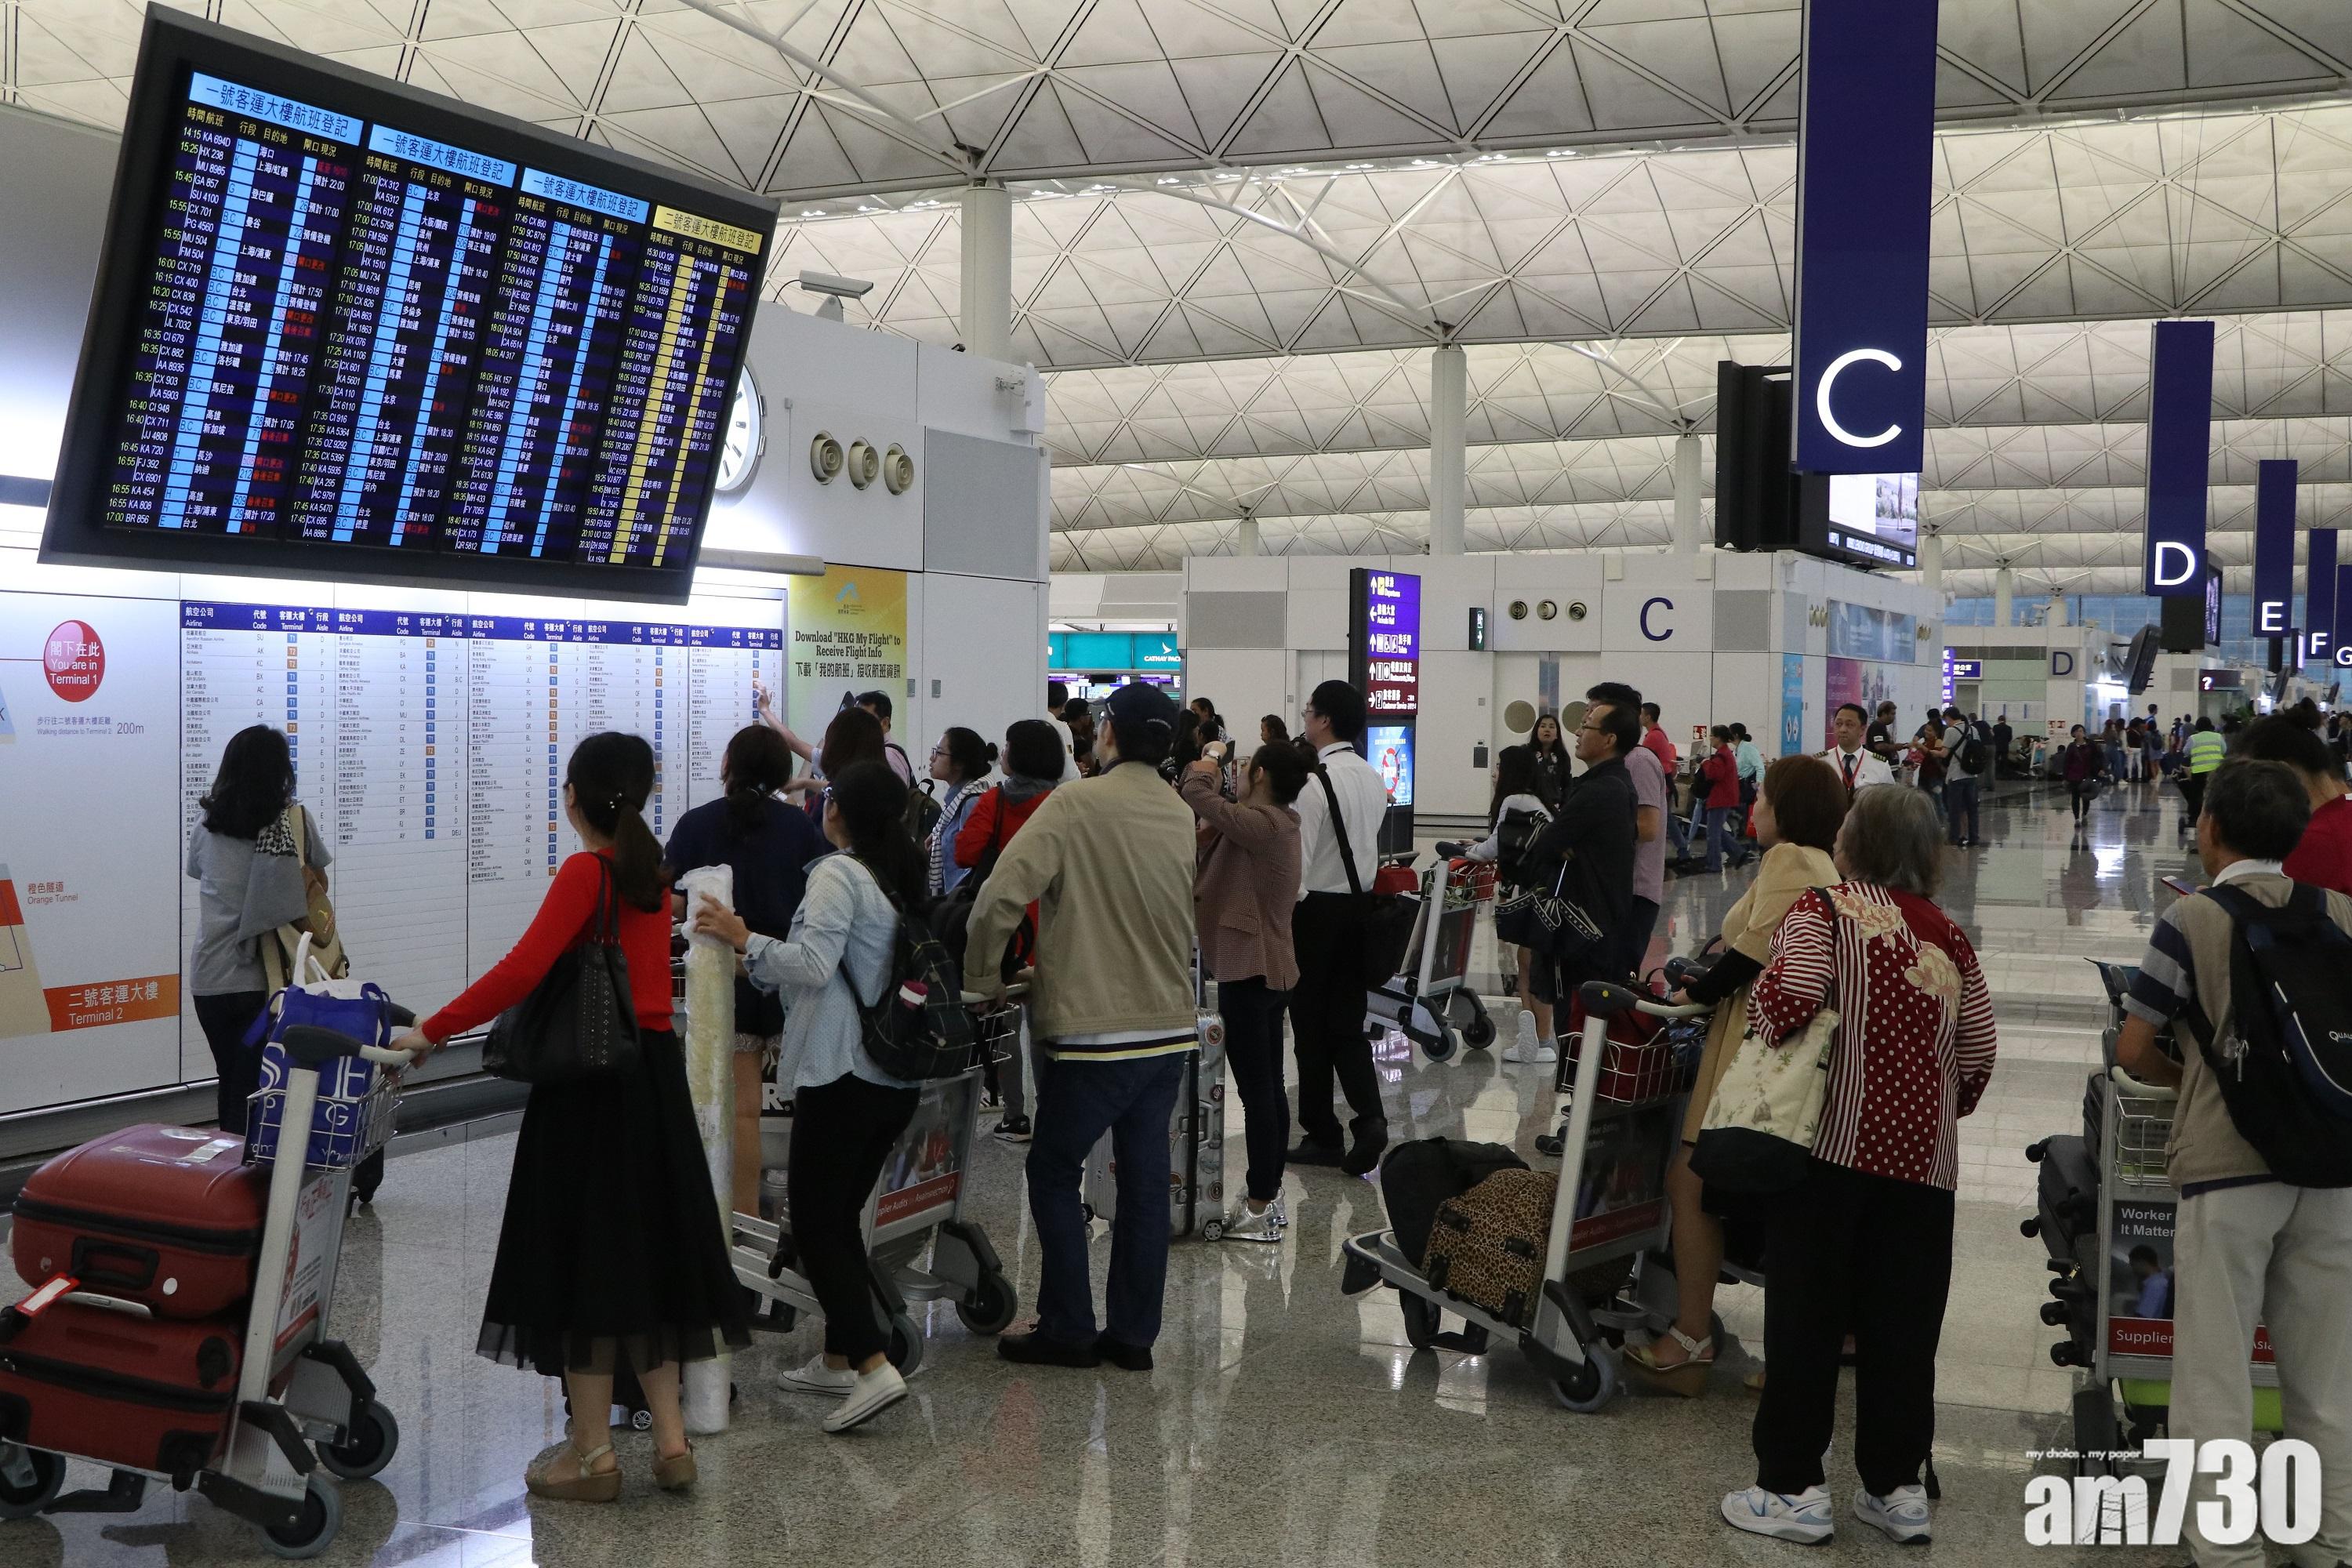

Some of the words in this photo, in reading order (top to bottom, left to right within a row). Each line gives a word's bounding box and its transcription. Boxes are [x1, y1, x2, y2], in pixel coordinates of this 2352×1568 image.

[205, 84, 349, 138] 一號客運大樓航班登記
[182, 125, 201, 140] 14:15
[201, 131, 213, 143] KA
[259, 146, 275, 159] 海口
[263, 126, 289, 145] 目的地
[180, 140, 199, 154] 15:25
[199, 146, 210, 158] HX
[313, 174, 328, 187] 預計
[328, 178, 345, 191] 22:00
[382, 134, 504, 181] 一號客運大樓航班登記
[194, 174, 205, 186] GA
[205, 177, 218, 189] 857
[307, 201, 323, 215] 預計
[323, 205, 339, 218] 17:00
[202, 191, 220, 204] 4100
[532, 177, 638, 218] 一號客運大樓航班登記
[188, 203, 200, 215] CX
[199, 205, 212, 217] 701
[664, 215, 754, 249] 二號客運大樓航班登記
[176, 260, 188, 271] CX
[187, 263, 201, 274] 719
[173, 274, 185, 285] CX
[185, 277, 198, 288] 400
[231, 285, 247, 298] 台北
[1817, 348, 1902, 448] C
[136, 514, 150, 524] 856
[182, 517, 198, 528] 台北
[2154, 542, 2195, 586] D
[186, 607, 213, 618] 航空公司
[253, 610, 267, 619] 代號
[279, 612, 305, 621] 客運大樓
[316, 612, 328, 622] 行段
[339, 613, 363, 623] 航空公司
[397, 616, 408, 626] 代號
[452, 619, 463, 627] 行段
[1640, 597, 1675, 641] C
[2262, 601, 2283, 631] E
[796, 630, 832, 643] Download
[834, 632, 854, 643] "HKG
[856, 633, 867, 647] My
[869, 633, 892, 647] Flight"
[895, 636, 900, 645] to
[2311, 633, 2328, 655] F
[50, 641, 100, 657] 閣下在此
[816, 645, 844, 657] Receive
[846, 645, 866, 659] Flight
[869, 647, 882, 658] Info
[2336, 647, 2352, 665] G
[52, 659, 70, 670] You
[71, 661, 86, 670] are
[89, 660, 97, 670] in
[2053, 652, 2073, 675] D
[50, 673, 89, 684] Terminal
[93, 674, 97, 684] 1
[118, 722, 143, 735] 200m
[28, 881, 64, 895] 橙色隧道
[27, 895, 53, 905] Orange
[56, 894, 78, 902] Tunnel
[69, 981, 158, 1007] 二號客運大樓
[69, 1009, 113, 1025] Terminal
[118, 1007, 123, 1019] 2
[2121, 1207, 2172, 1221] Worker
[2121, 1225, 2129, 1235] It
